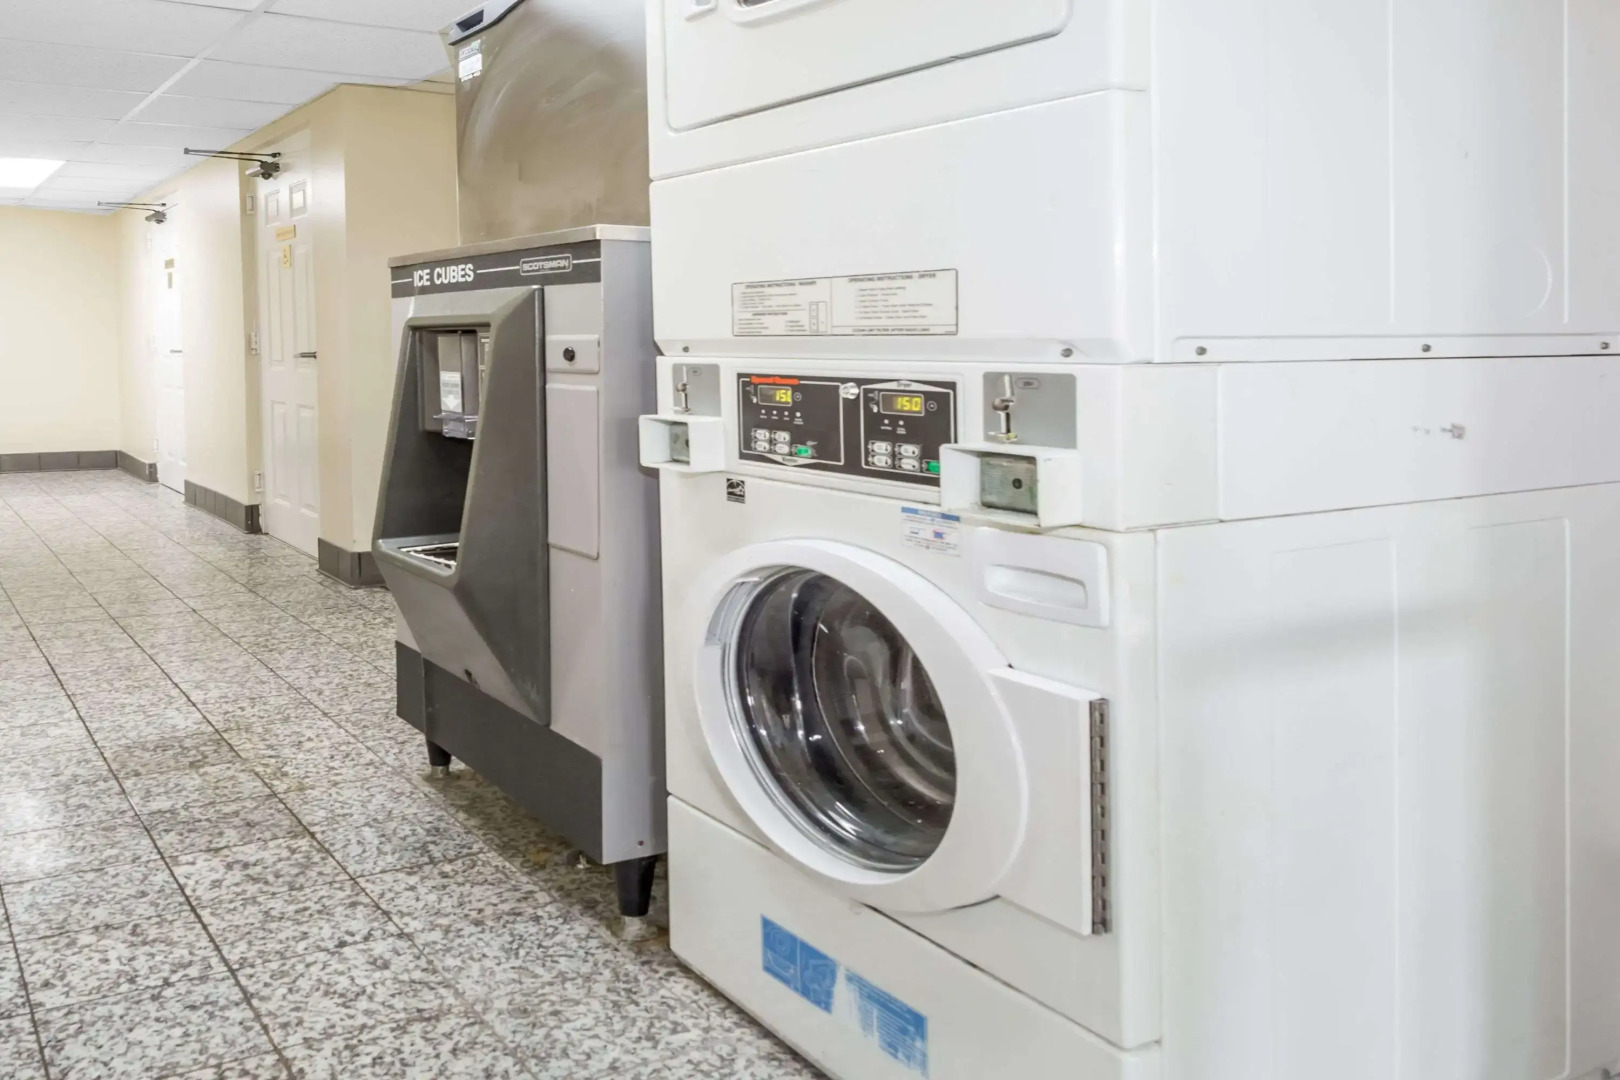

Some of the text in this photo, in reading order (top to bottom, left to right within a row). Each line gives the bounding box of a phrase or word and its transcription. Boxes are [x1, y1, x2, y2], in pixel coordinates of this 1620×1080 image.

[522, 259, 569, 271] SCOTSMAN
[413, 263, 474, 287] ICE CUBES
[897, 397, 921, 411] 150
